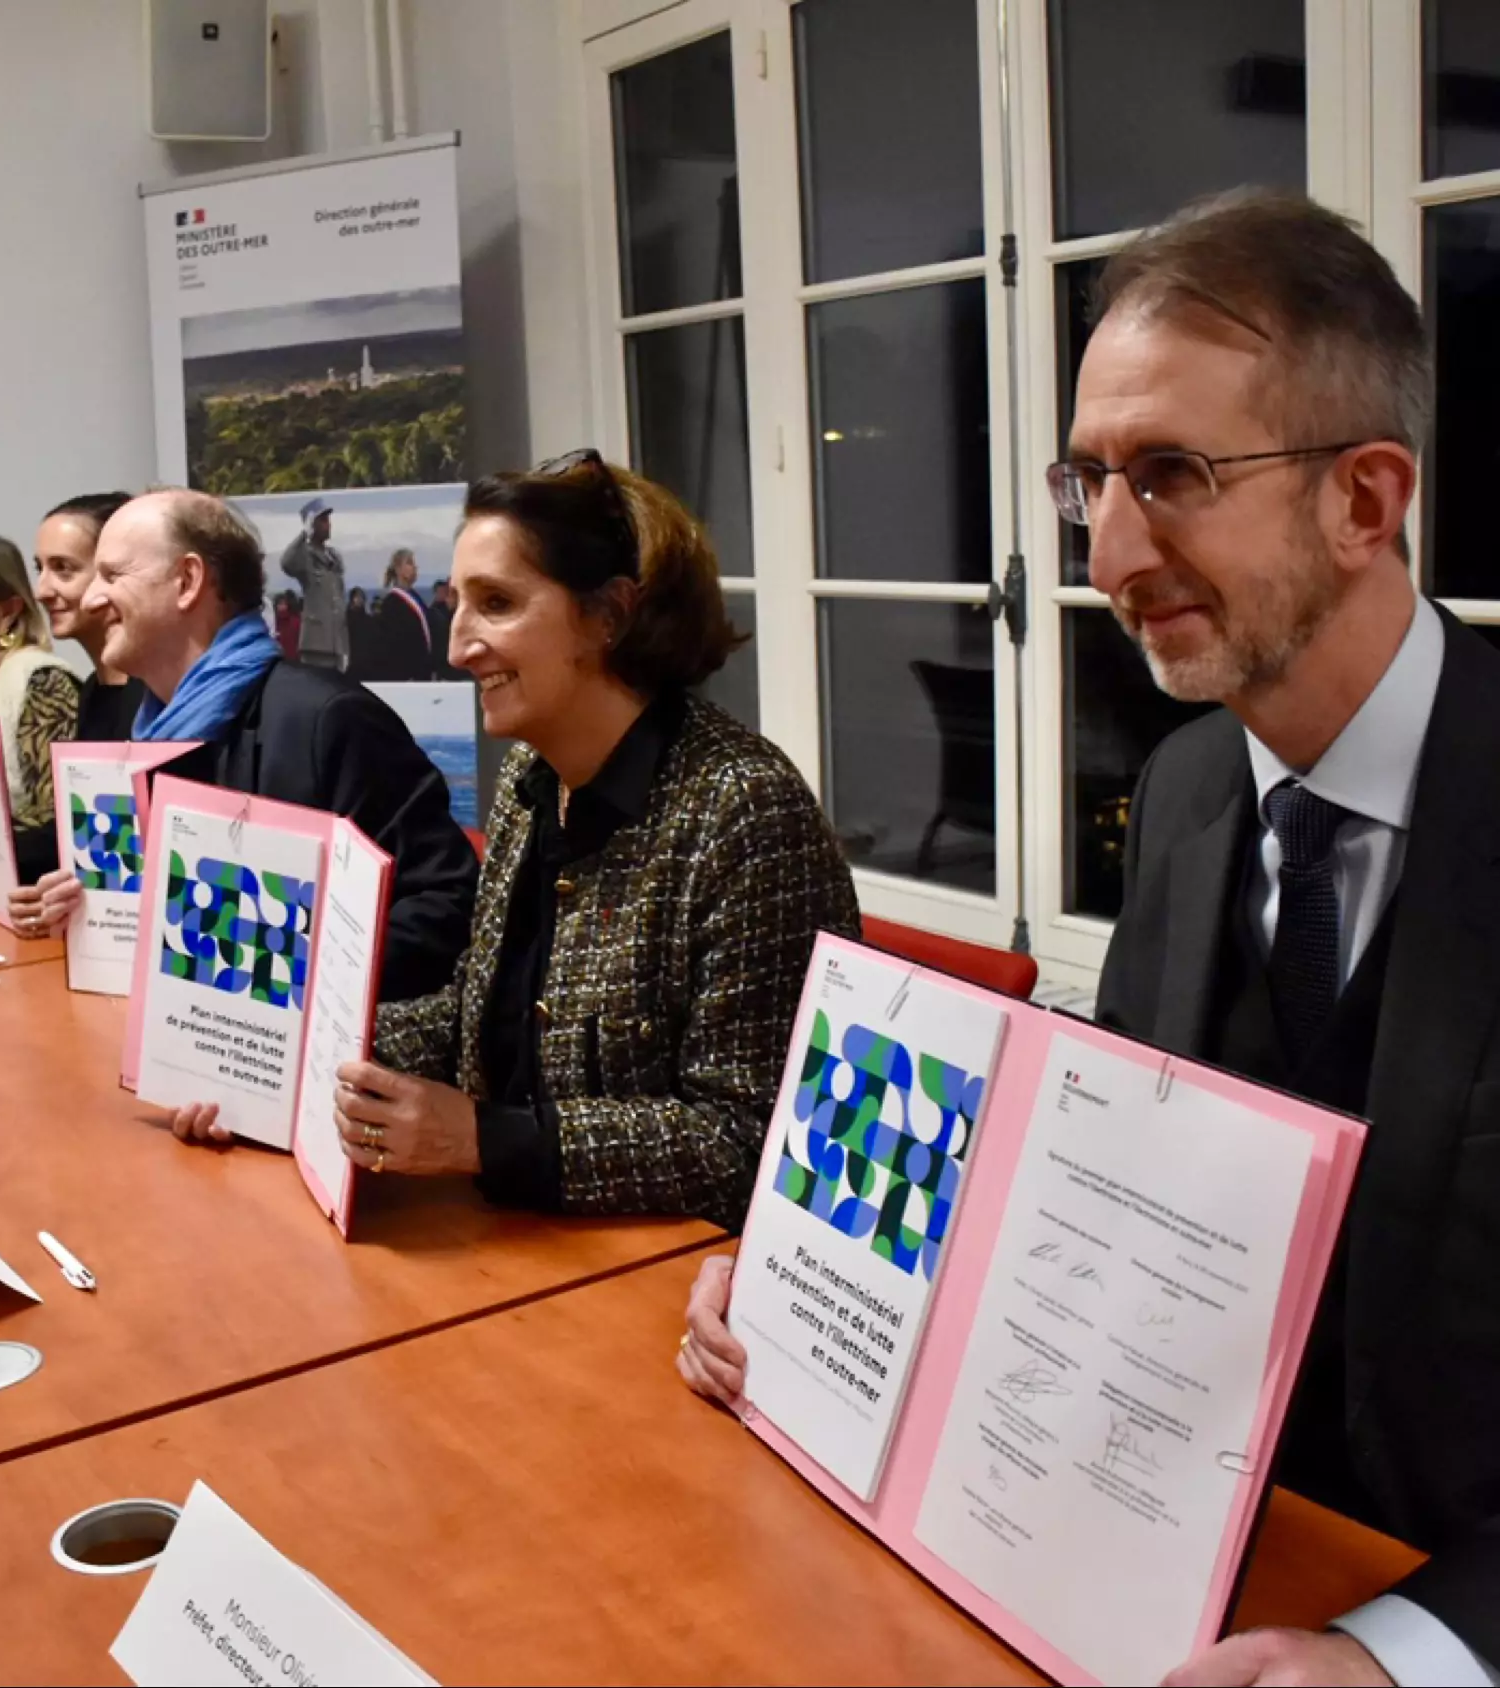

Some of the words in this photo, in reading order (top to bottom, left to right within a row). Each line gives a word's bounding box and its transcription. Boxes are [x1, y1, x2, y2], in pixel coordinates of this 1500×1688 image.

[314, 206, 367, 223] Direction
[370, 198, 420, 218] générale
[339, 223, 359, 237] des
[363, 217, 420, 235] outre-mer
[177, 247, 198, 260] DES
[191, 1004, 211, 1020] Plan
[166, 1014, 178, 1026] de
[234, 1036, 244, 1046] et
[246, 1038, 258, 1051] de
[219, 1064, 230, 1073] en
[766, 1254, 780, 1273] de
[778, 1267, 836, 1312] prévention
[838, 1303, 850, 1319] et
[851, 1312, 866, 1333] de
[867, 1320, 894, 1354] lutte
[795, 1246, 818, 1271] Plan
[820, 1261, 904, 1329] interministériel
[790, 1301, 824, 1332] contre
[811, 1344, 825, 1362] en
[826, 1354, 880, 1404] outre-mer
[182, 1599, 216, 1643] Préfet,
[214, 1634, 264, 1687] directeur
[224, 1598, 282, 1662] Monsieur
